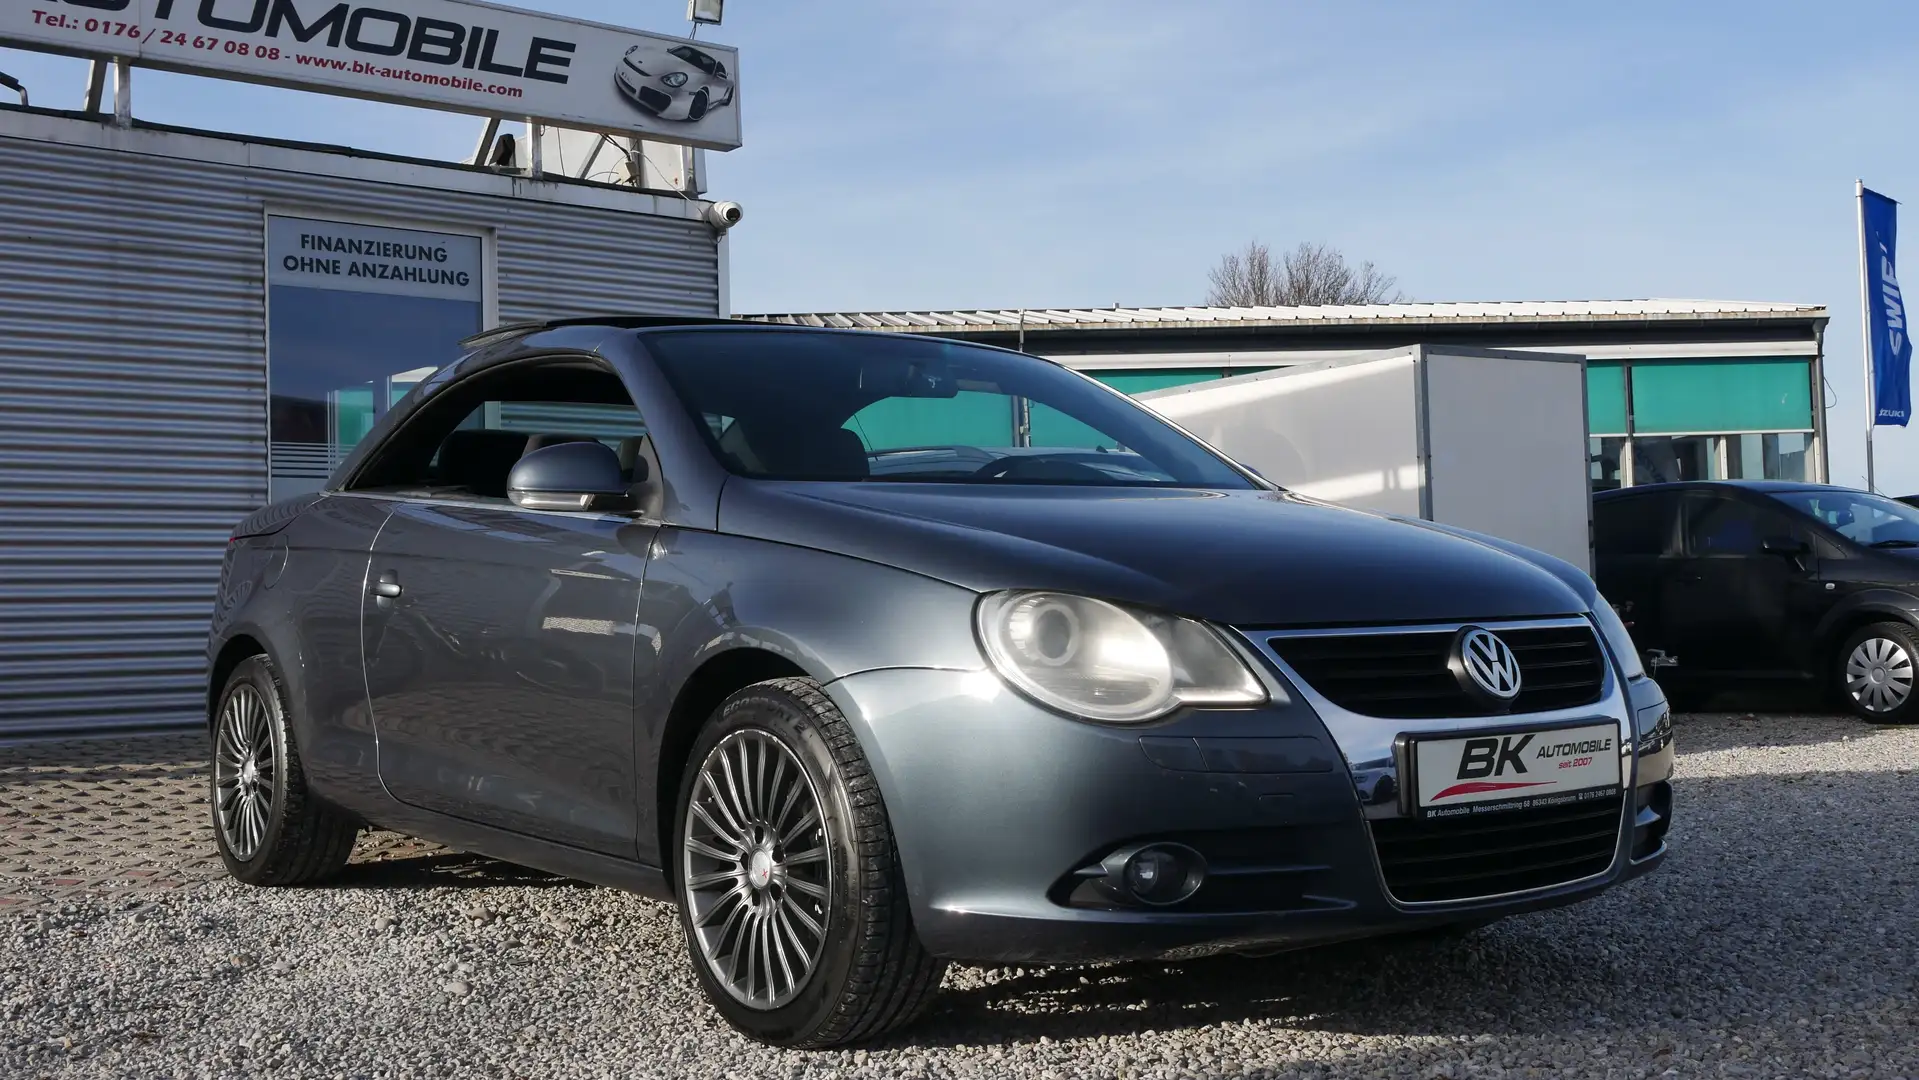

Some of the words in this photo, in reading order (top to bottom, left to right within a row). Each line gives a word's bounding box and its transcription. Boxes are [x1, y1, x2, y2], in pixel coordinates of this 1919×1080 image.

[32, 9, 79, 30] Tel.:
[84, 18, 141, 39] 0176
[160, 30, 187, 46] 24
[192, 35, 219, 51] 67
[223, 40, 250, 56] 08
[254, 45, 280, 61] 08
[295, 53, 524, 98] www.bk-automobile.com
[43, 0, 576, 84] OMOBILE
[300, 233, 449, 263] FINANZIERUNG
[282, 254, 341, 276] OHNE
[347, 260, 471, 287] ANZAHLUNG
[1456, 733, 1537, 780] BK
[1536, 738, 1613, 760] AUTOMOBILE
[1572, 756, 1593, 767] 2007
[1427, 810, 1437, 818] BK
[1437, 806, 1471, 817] Automobile
